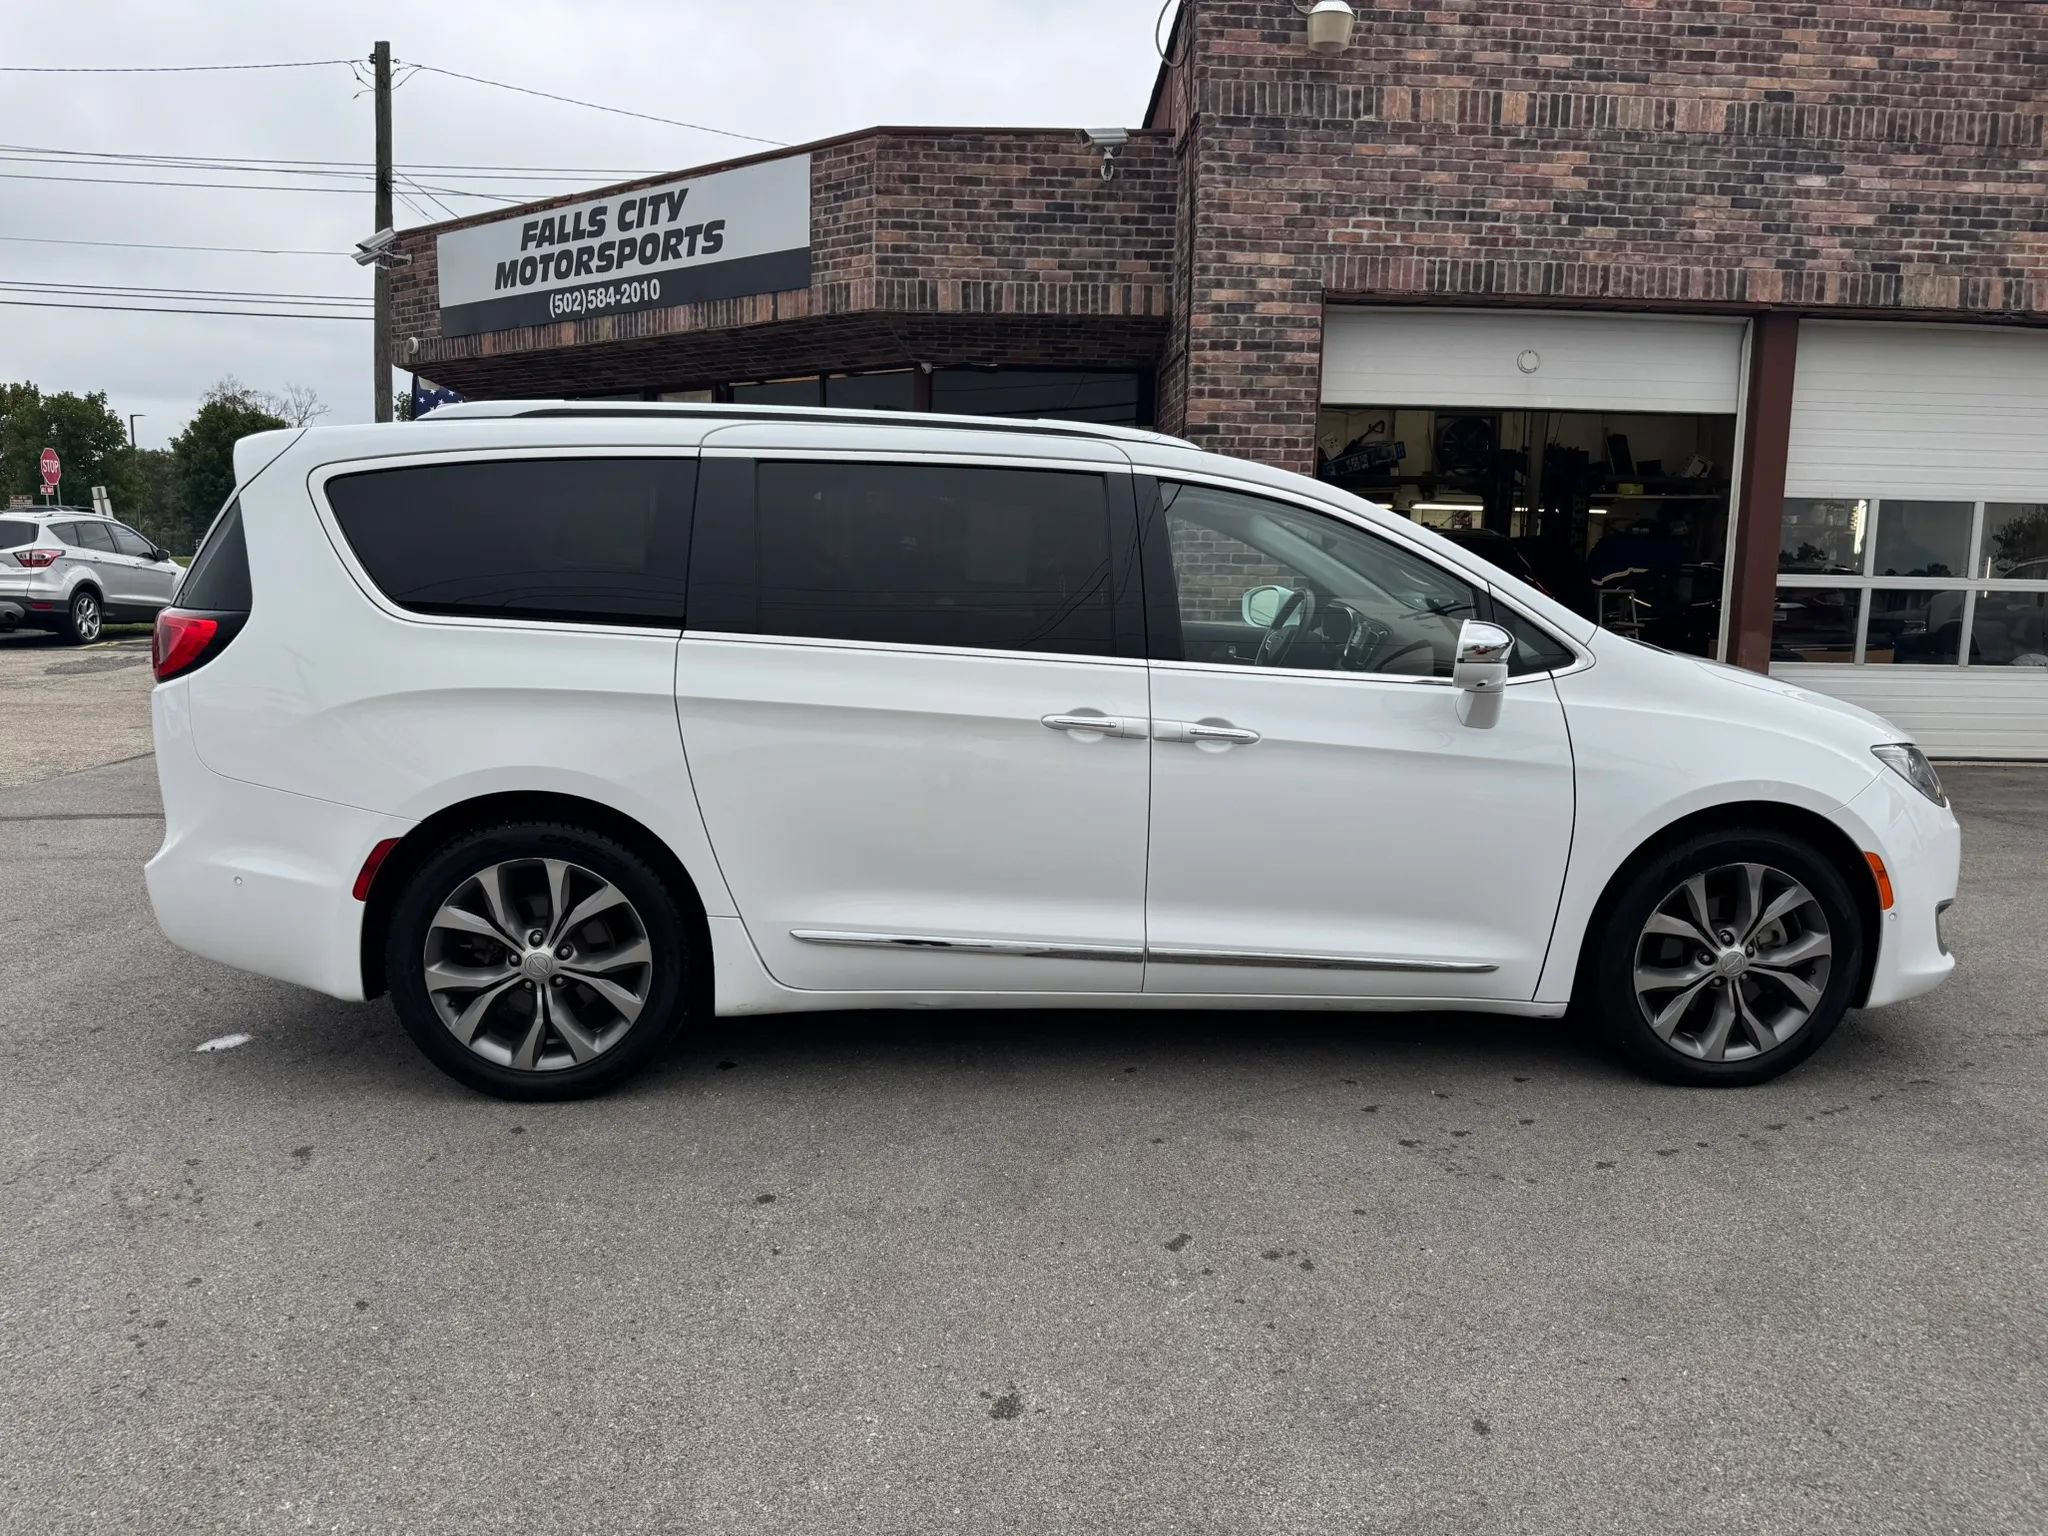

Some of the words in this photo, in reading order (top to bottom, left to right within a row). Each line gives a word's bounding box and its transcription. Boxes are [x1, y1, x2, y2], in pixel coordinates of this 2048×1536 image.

[520, 206, 608, 251] FALLS
[617, 188, 689, 232] CITY
[495, 220, 726, 290] MOTORSPORTS
[549, 279, 661, 318] (502)584-2010
[42, 459, 59, 473] STOP
